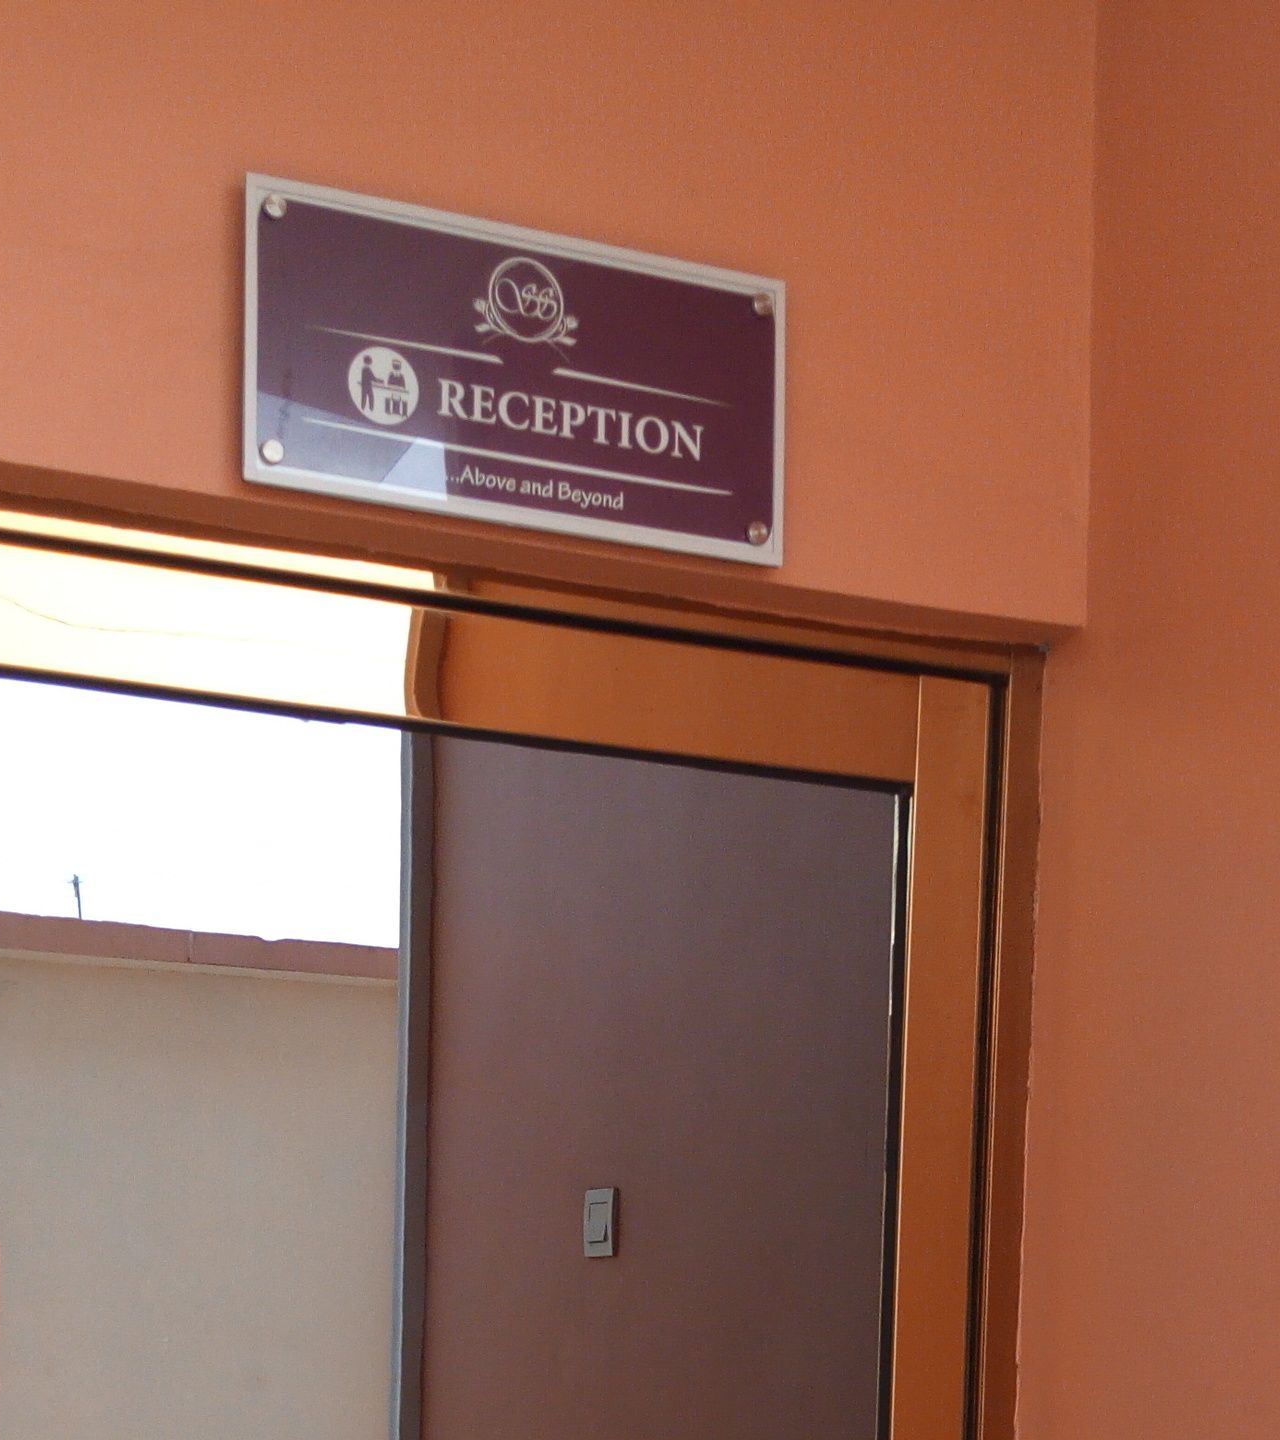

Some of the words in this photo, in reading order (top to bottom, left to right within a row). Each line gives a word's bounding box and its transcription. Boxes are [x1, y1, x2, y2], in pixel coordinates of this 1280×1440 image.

[437, 378, 704, 462] RECEPTION
[520, 479, 554, 499] and
[557, 481, 625, 511] Beyond
